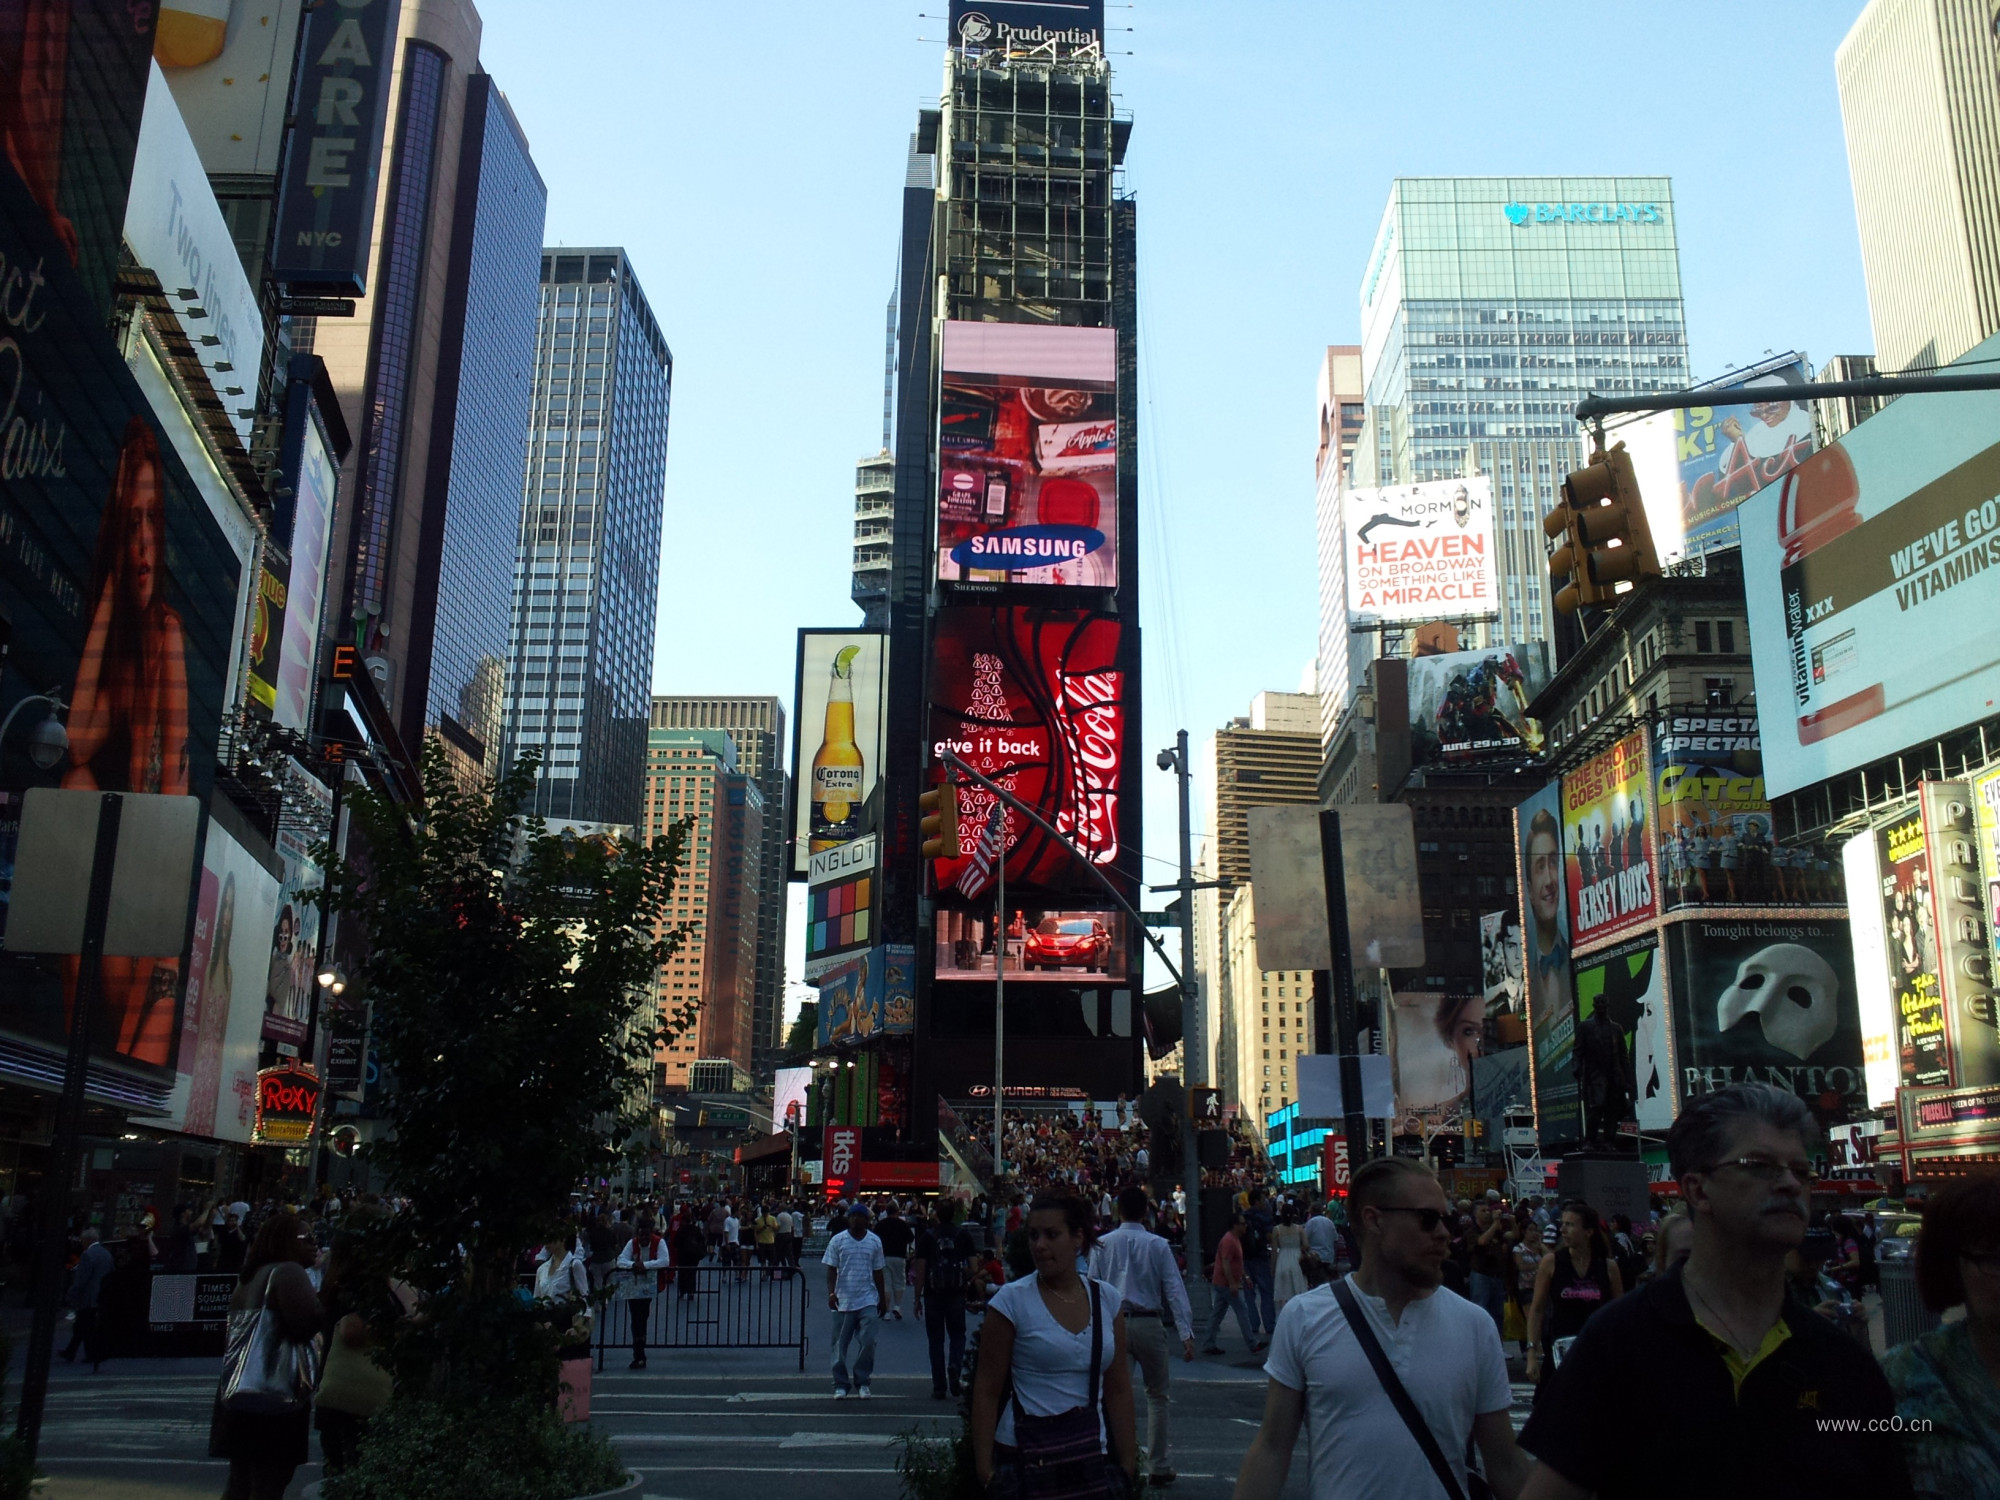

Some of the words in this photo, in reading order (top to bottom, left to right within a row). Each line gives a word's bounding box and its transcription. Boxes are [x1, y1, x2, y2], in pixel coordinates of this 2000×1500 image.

[996, 22, 1097, 46] Prudential
[305, 0, 373, 187] ARE
[1535, 202, 1659, 223] BARCLAYS
[169, 178, 200, 287] Two
[297, 231, 342, 247] NYC
[203, 262, 237, 363] lines
[1068, 427, 1105, 450] Apple
[1688, 505, 1720, 524] MUSICAL
[971, 535, 1087, 558] SAMSUNG
[1357, 533, 1484, 565] HEAVEN
[1890, 519, 1961, 580] WE'VE
[1358, 566, 1383, 578] ON
[1389, 556, 1485, 576] BROADWAY
[1359, 573, 1449, 590] SOMETHING
[1453, 569, 1486, 581] LIKE
[1360, 591, 1376, 608] A
[1382, 582, 1487, 606] MIRACLE
[333, 645, 356, 679] E
[1656, 720, 1666, 738] A
[934, 739, 974, 758] give
[979, 738, 992, 753] it
[998, 738, 1040, 757] back
[1441, 741, 1471, 752] JUNE
[1473, 740, 1491, 749] 29
[1502, 736, 1521, 745] 3D
[1594, 734, 1643, 778] CROWD
[816, 766, 860, 783] Corona
[825, 780, 853, 788] Extra
[1569, 778, 1603, 811] GOES
[809, 840, 875, 878] INGLOT
[1577, 875, 1617, 932] JERSEY
[1619, 861, 1652, 916] BOYS
[1944, 800, 1989, 1021] PALACE
[1701, 923, 1752, 941] Tonight
[1754, 923, 1804, 941] belongs
[1912, 972, 1936, 993] The
[1967, 1098, 1975, 1107] OF
[1975, 1096, 1987, 1106] THE
[832, 1130, 856, 1175] tkts
[1457, 1180, 1497, 1192] GIFTS
[202, 1283, 231, 1292] TIMES
[150, 1323, 174, 1332] TIMES
[203, 1323, 219, 1331] NYC
